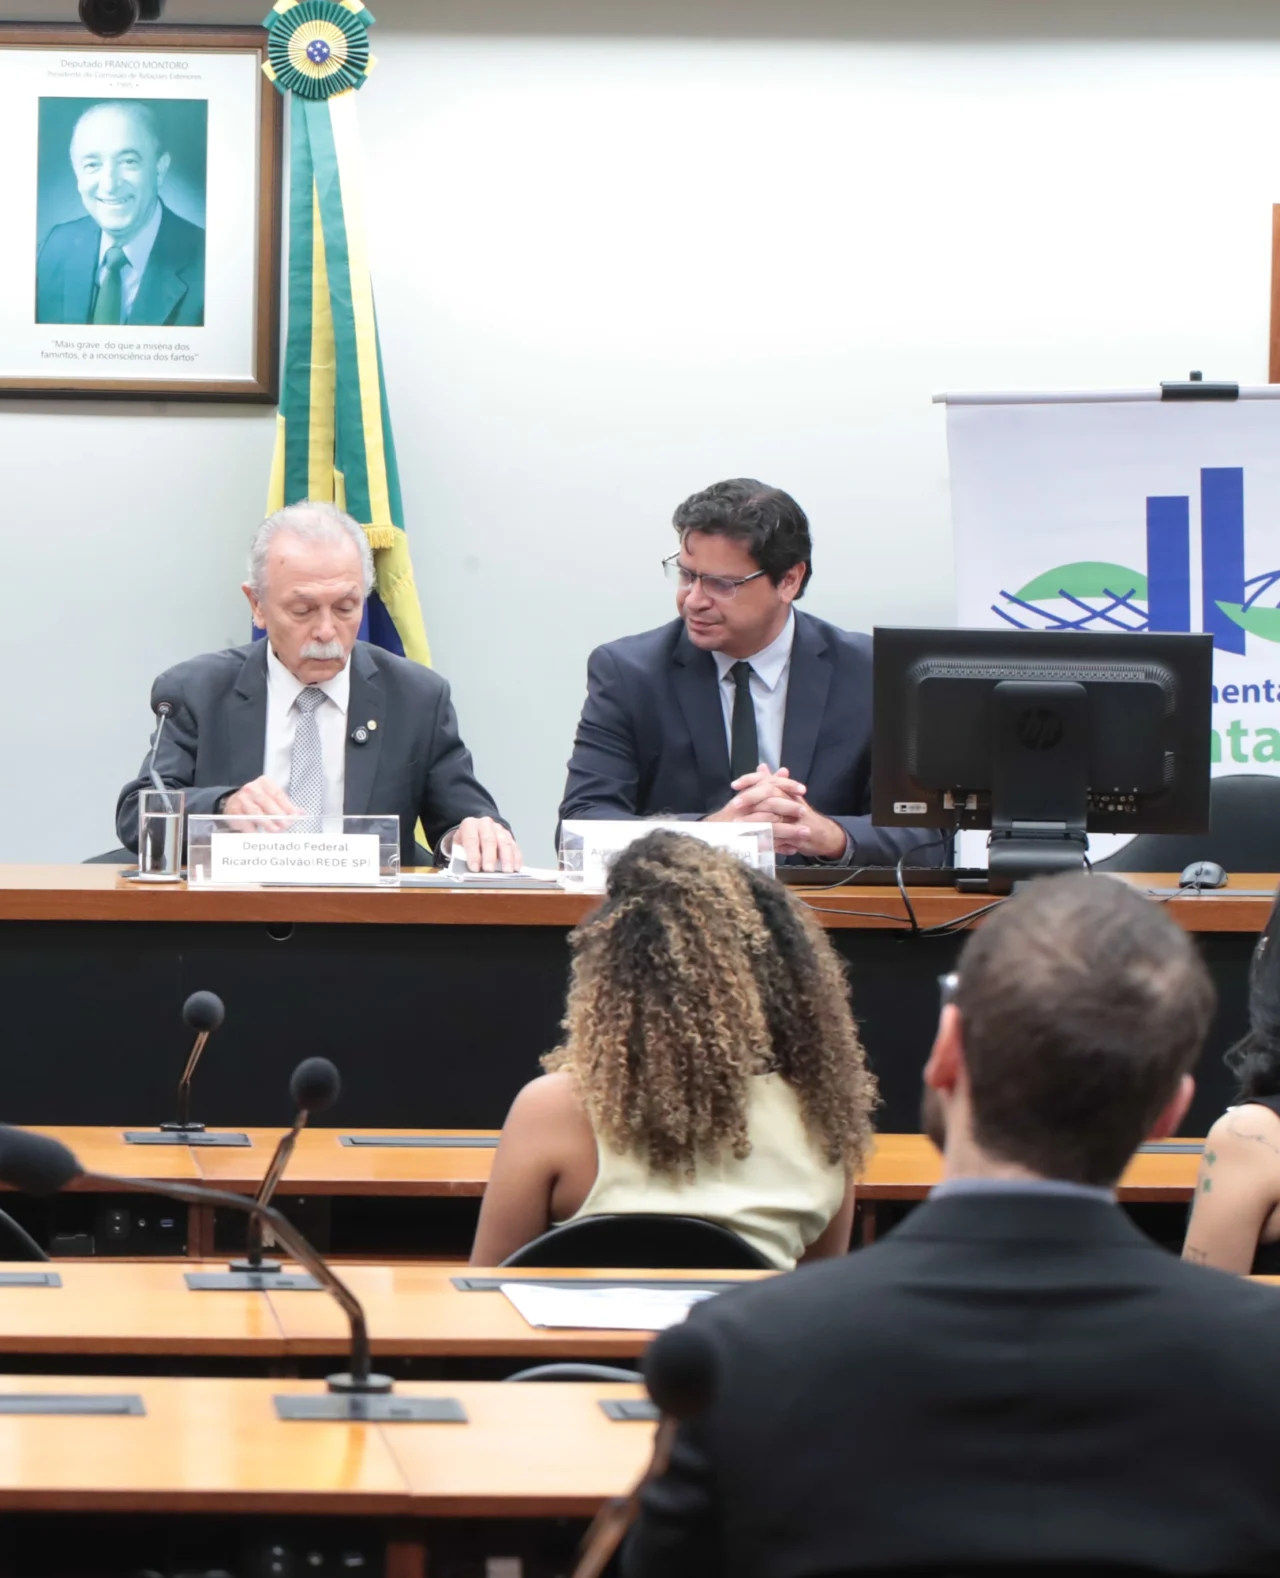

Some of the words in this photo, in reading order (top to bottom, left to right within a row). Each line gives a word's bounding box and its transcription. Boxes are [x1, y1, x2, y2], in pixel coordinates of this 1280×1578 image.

[60, 59, 103, 70] Deputado
[104, 60, 141, 70] FRANCO
[142, 61, 189, 70] MONTORO
[76, 341, 100, 351] grave
[104, 341, 116, 350] do
[117, 342, 134, 352] que
[174, 342, 190, 351] dos
[153, 352, 169, 361] dos
[242, 841, 301, 853] Deputado
[304, 841, 349, 852] Federal
[221, 856, 268, 867] Ricardo
